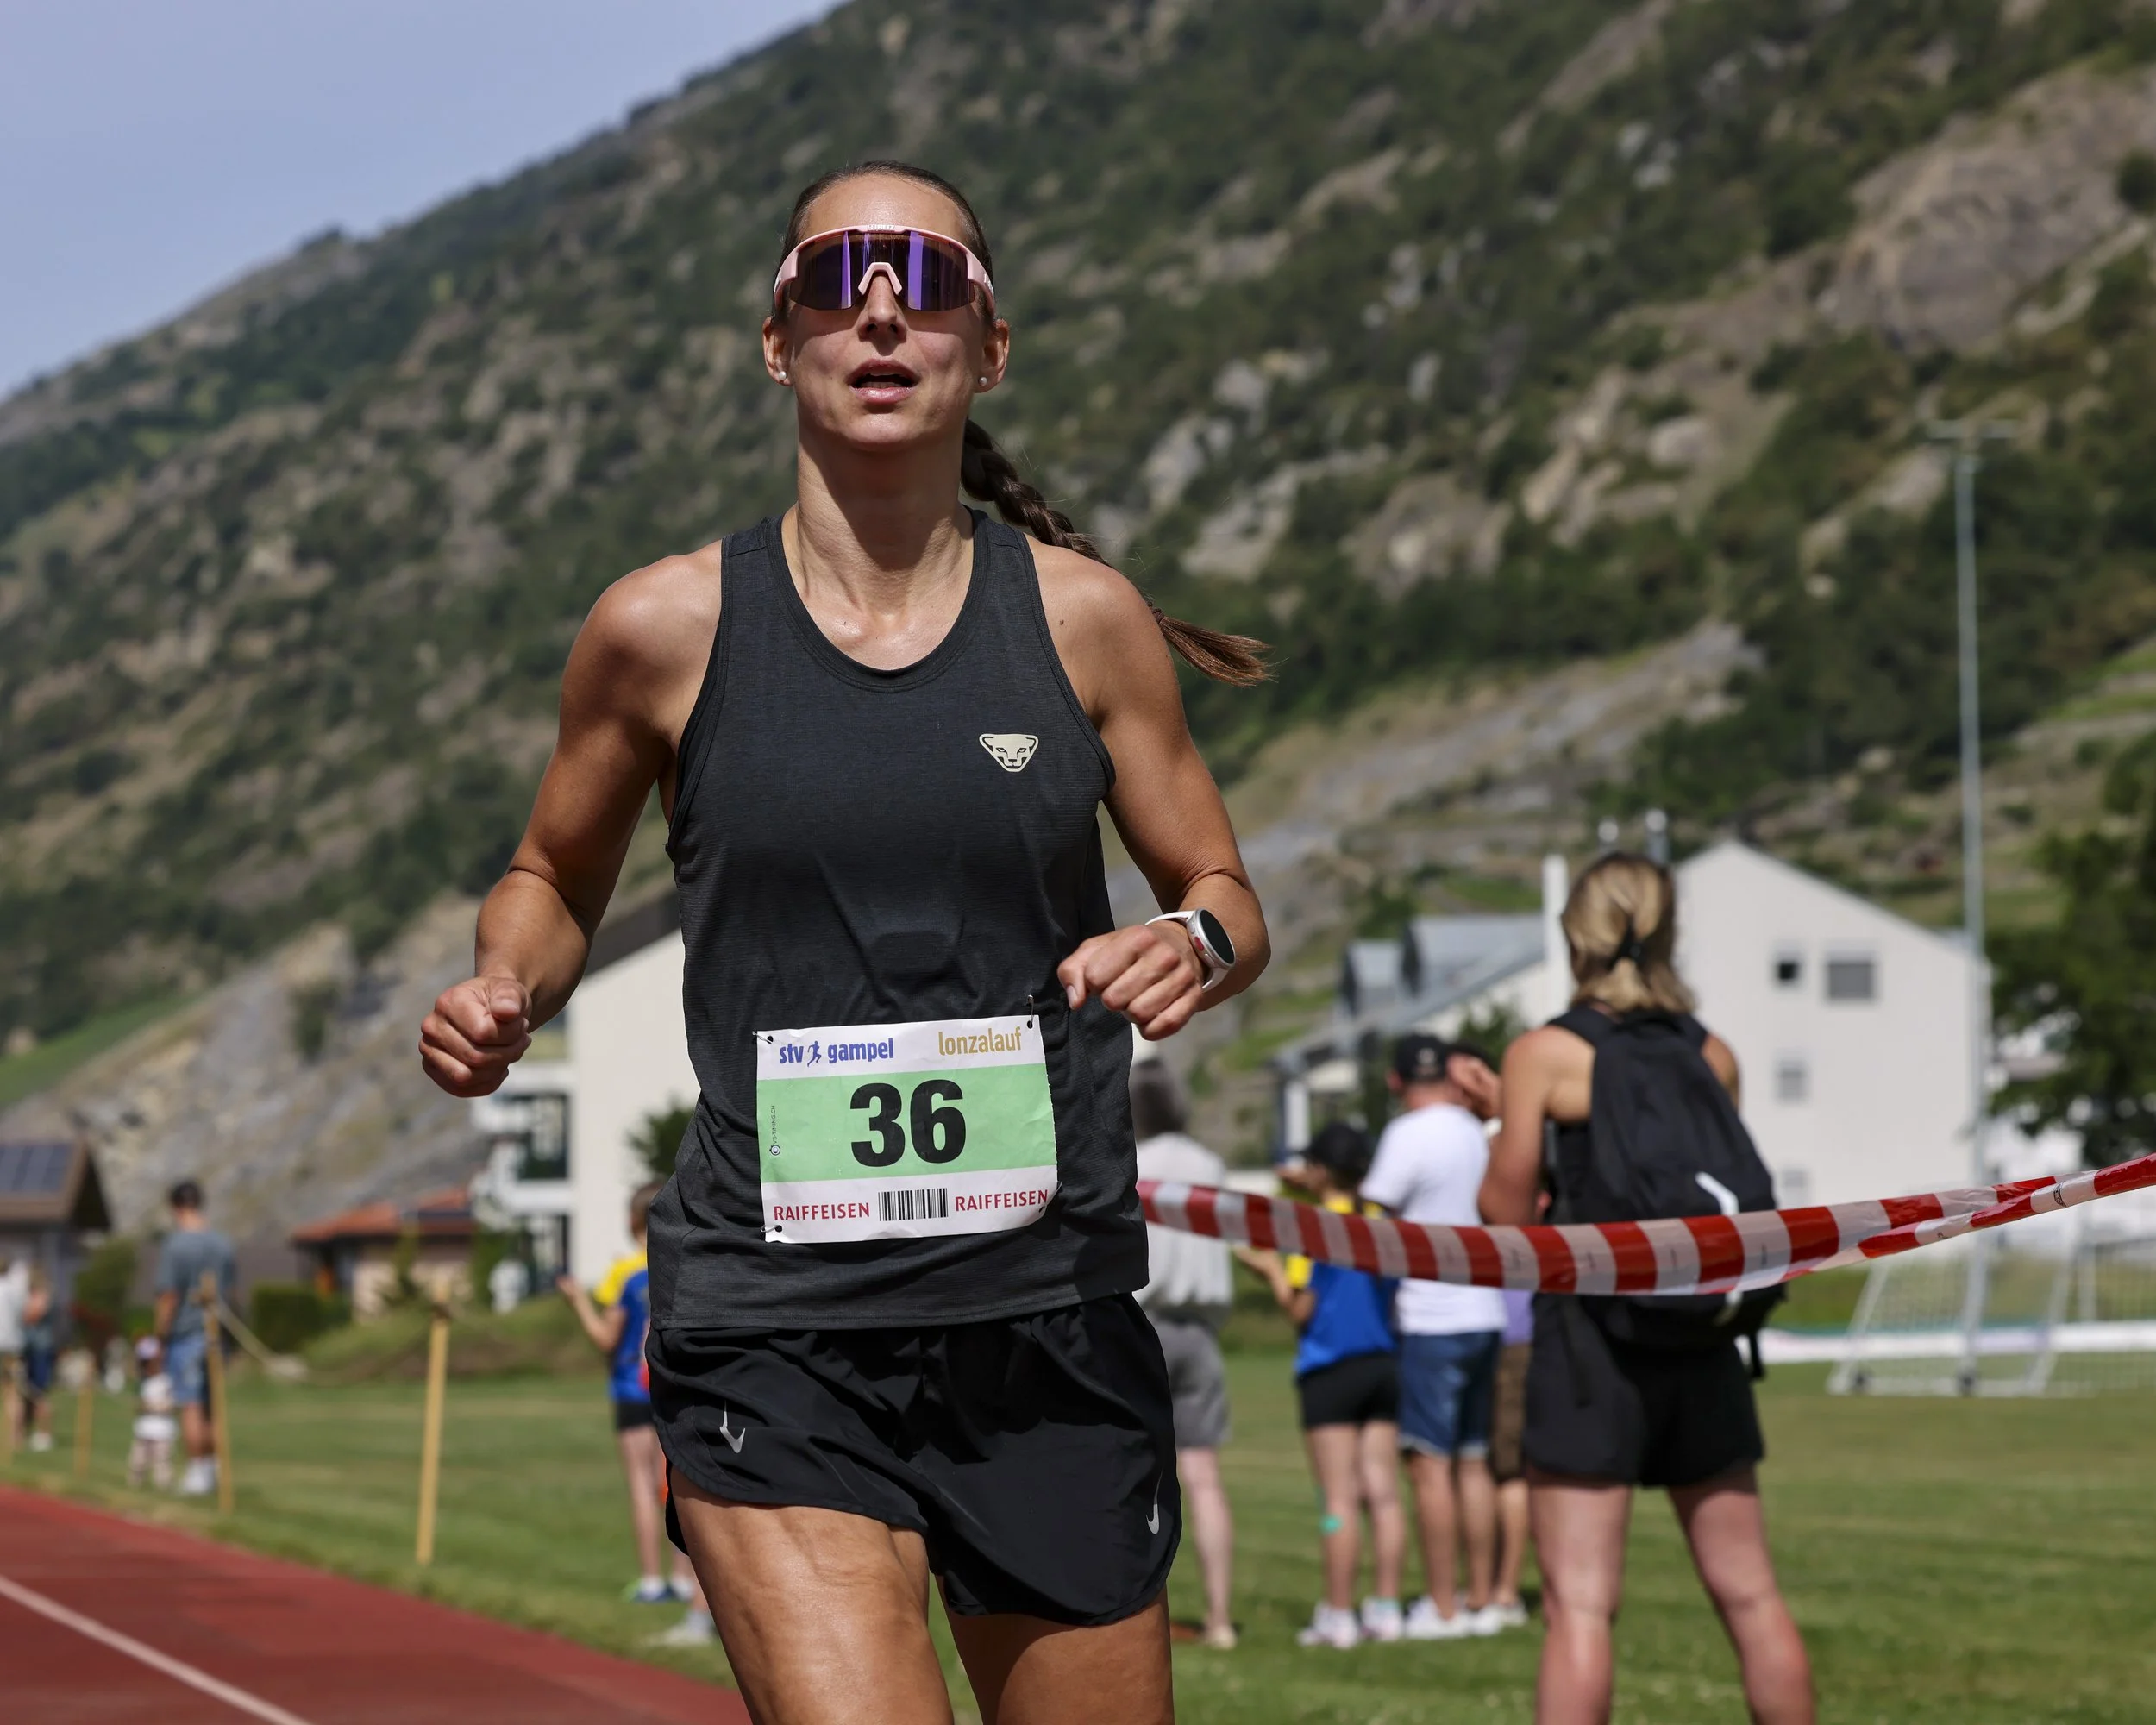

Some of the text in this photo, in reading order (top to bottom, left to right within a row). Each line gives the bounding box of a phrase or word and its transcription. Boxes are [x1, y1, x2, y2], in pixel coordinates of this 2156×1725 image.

[780, 1038, 894, 1064] stv gampel
[938, 1026, 1022, 1056] lonzalauf
[849, 1079, 967, 1168] 36
[774, 1202, 870, 1221] RAIFFEISEN
[955, 1189, 1048, 1212] RAIFFEISEN
